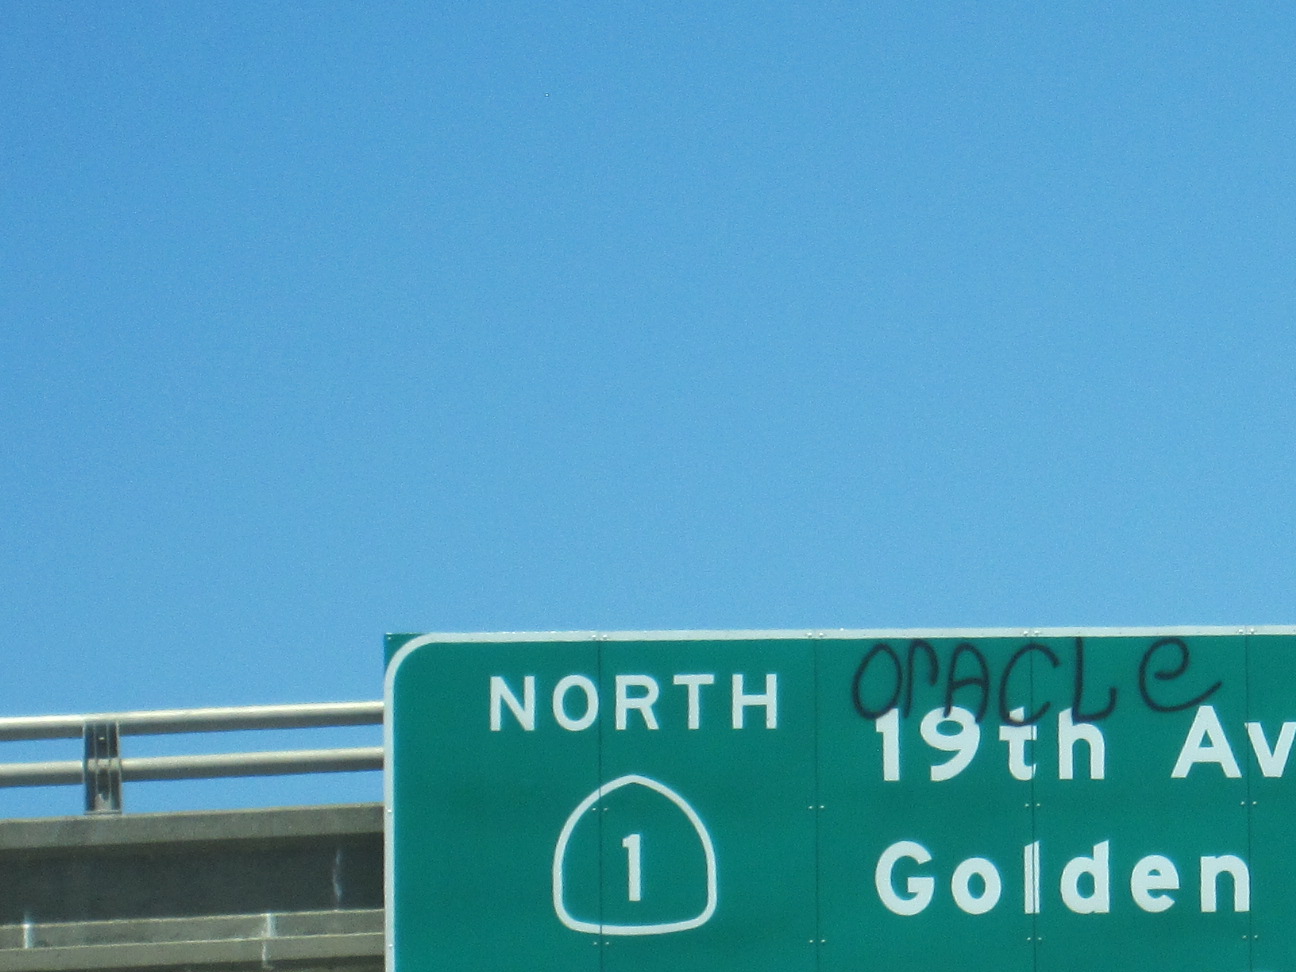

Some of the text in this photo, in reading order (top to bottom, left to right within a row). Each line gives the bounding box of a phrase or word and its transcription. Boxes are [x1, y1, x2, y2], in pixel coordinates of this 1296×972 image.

[491, 674, 777, 731] NORTH
[876, 707, 1104, 781] 19th
[623, 834, 640, 901] 1
[875, 841, 1250, 915] Golden
